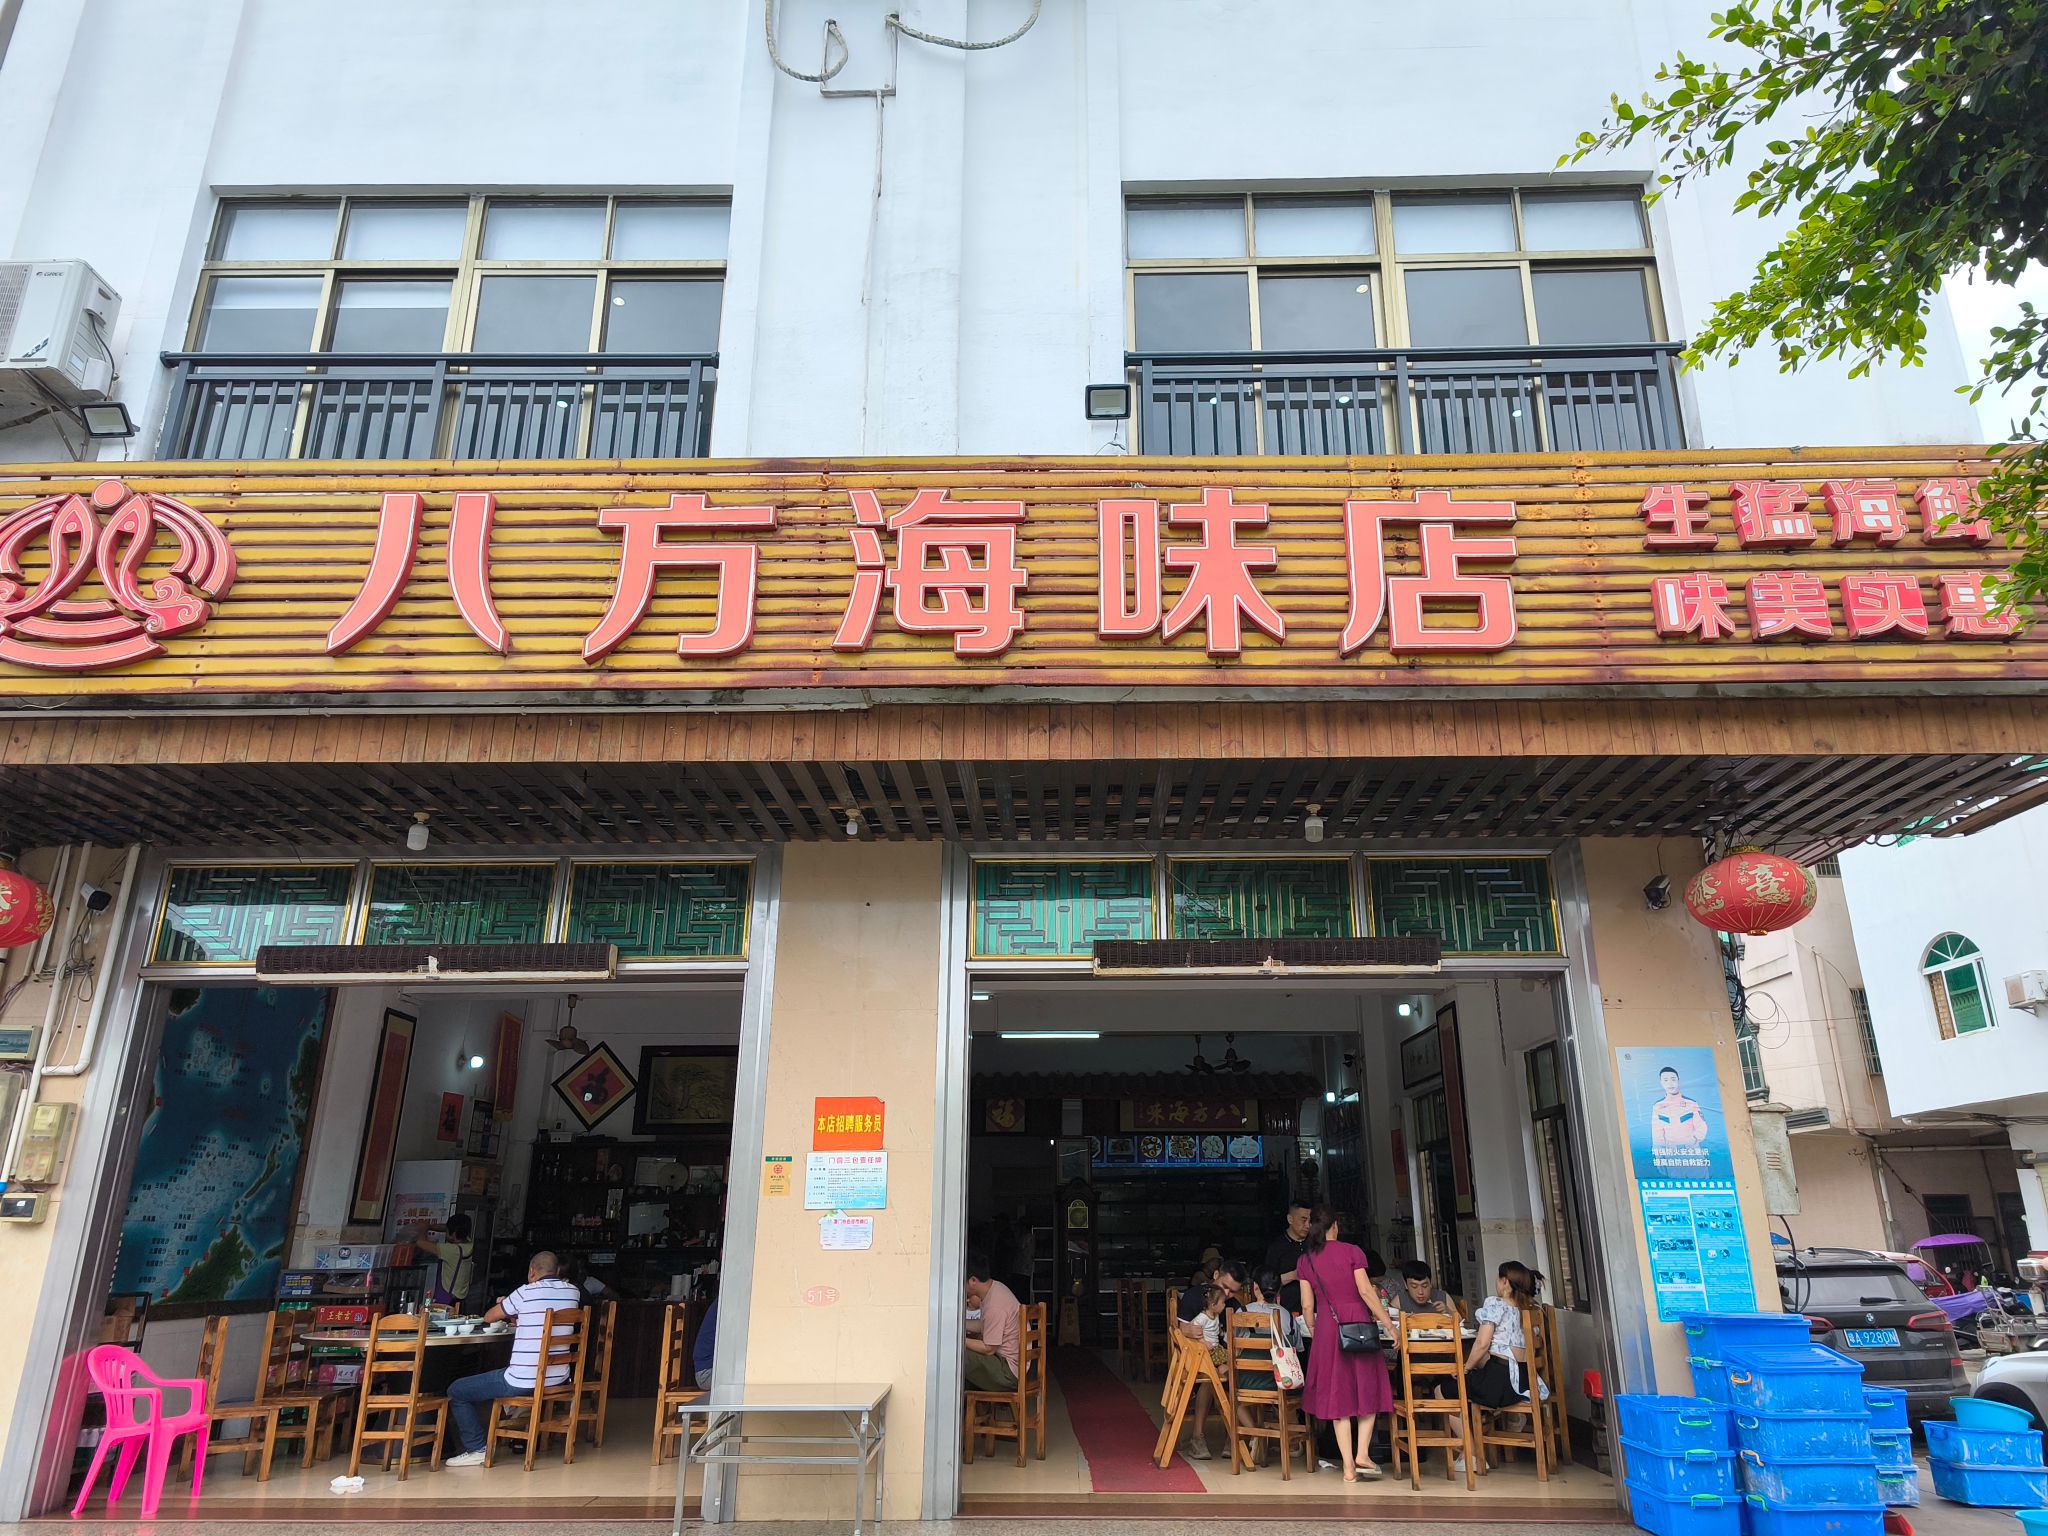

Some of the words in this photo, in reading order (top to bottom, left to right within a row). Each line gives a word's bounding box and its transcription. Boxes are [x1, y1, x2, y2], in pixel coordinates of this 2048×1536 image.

[326, 487, 1519, 664] 八方海味店
[1650, 570, 2024, 643] 味美实惠
[817, 1114, 881, 1134] 本店招聘服务员
[808, 1289, 836, 1304] 51号
